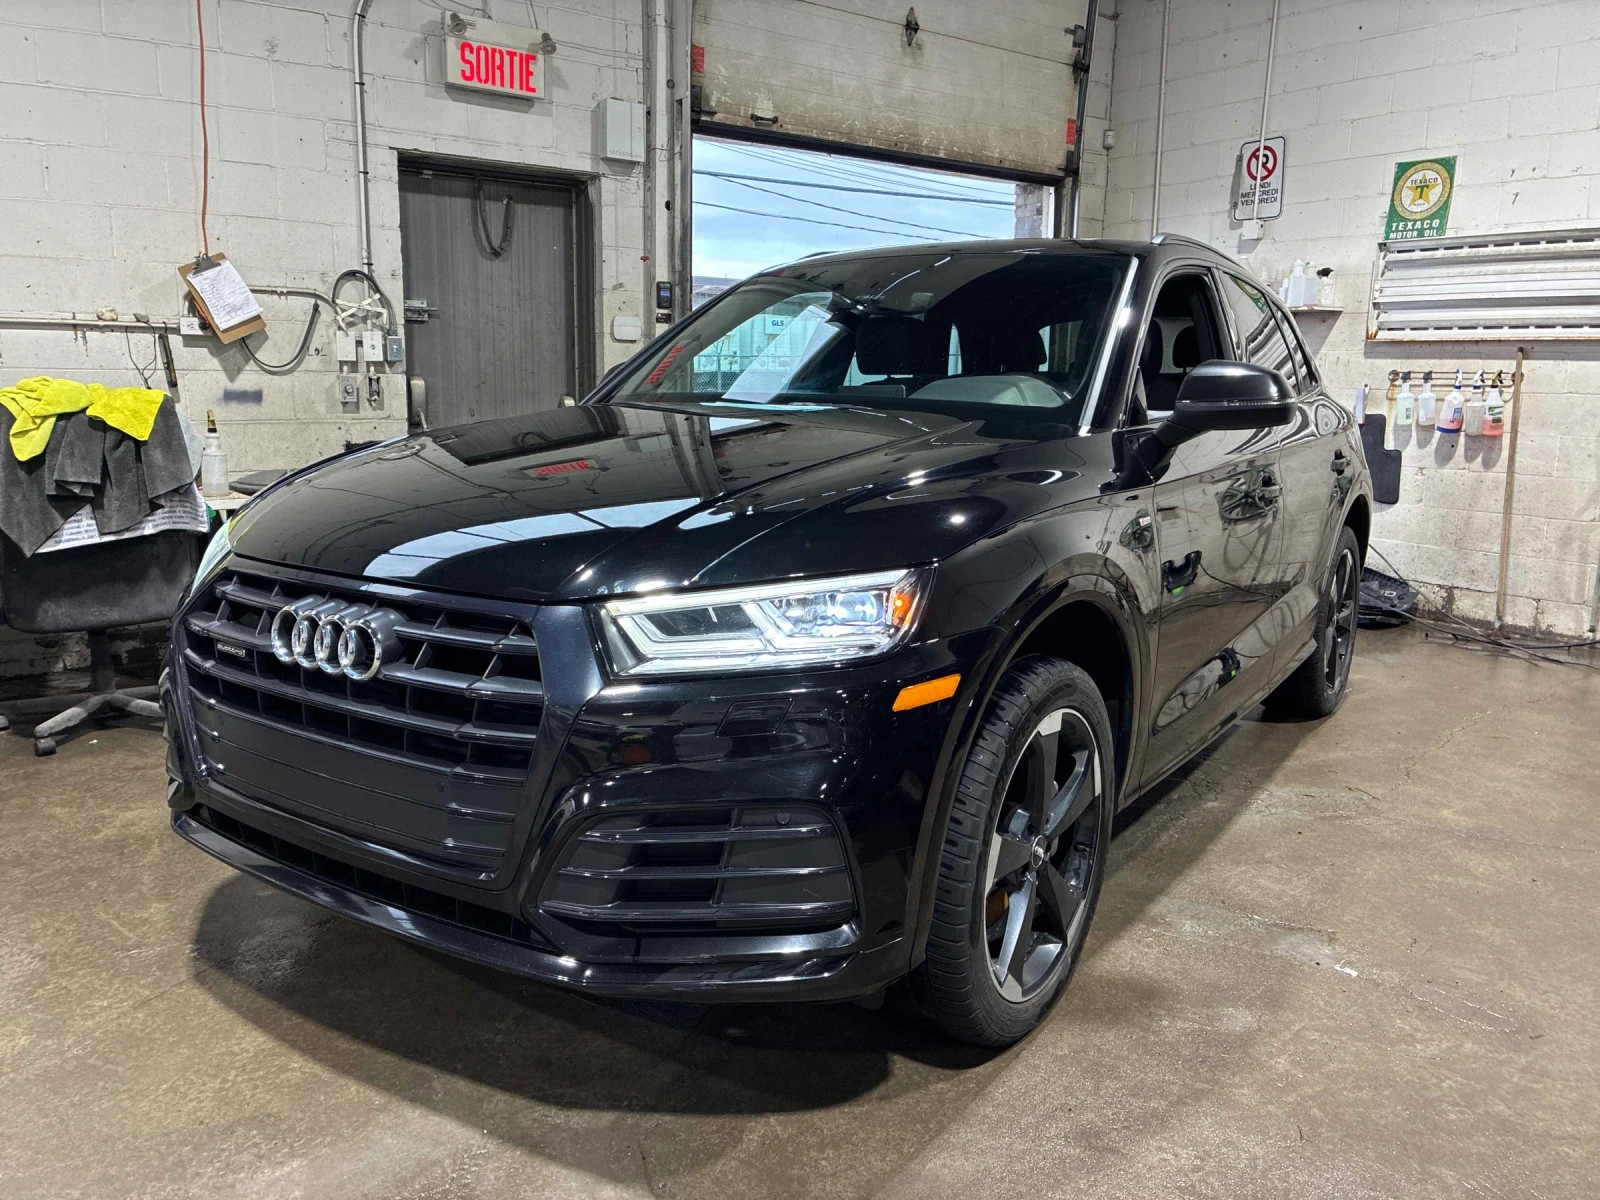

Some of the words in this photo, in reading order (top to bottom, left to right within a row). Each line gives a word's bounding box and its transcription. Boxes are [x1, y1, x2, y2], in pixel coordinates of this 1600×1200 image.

[460, 41, 537, 93] SORTIE
[1410, 177, 1438, 186] TEXACO
[1391, 219, 1440, 231] TEXACO
[1389, 230, 1418, 240] MOTOR
[1424, 228, 1438, 237] OIL
[771, 319, 784, 327] GLS
